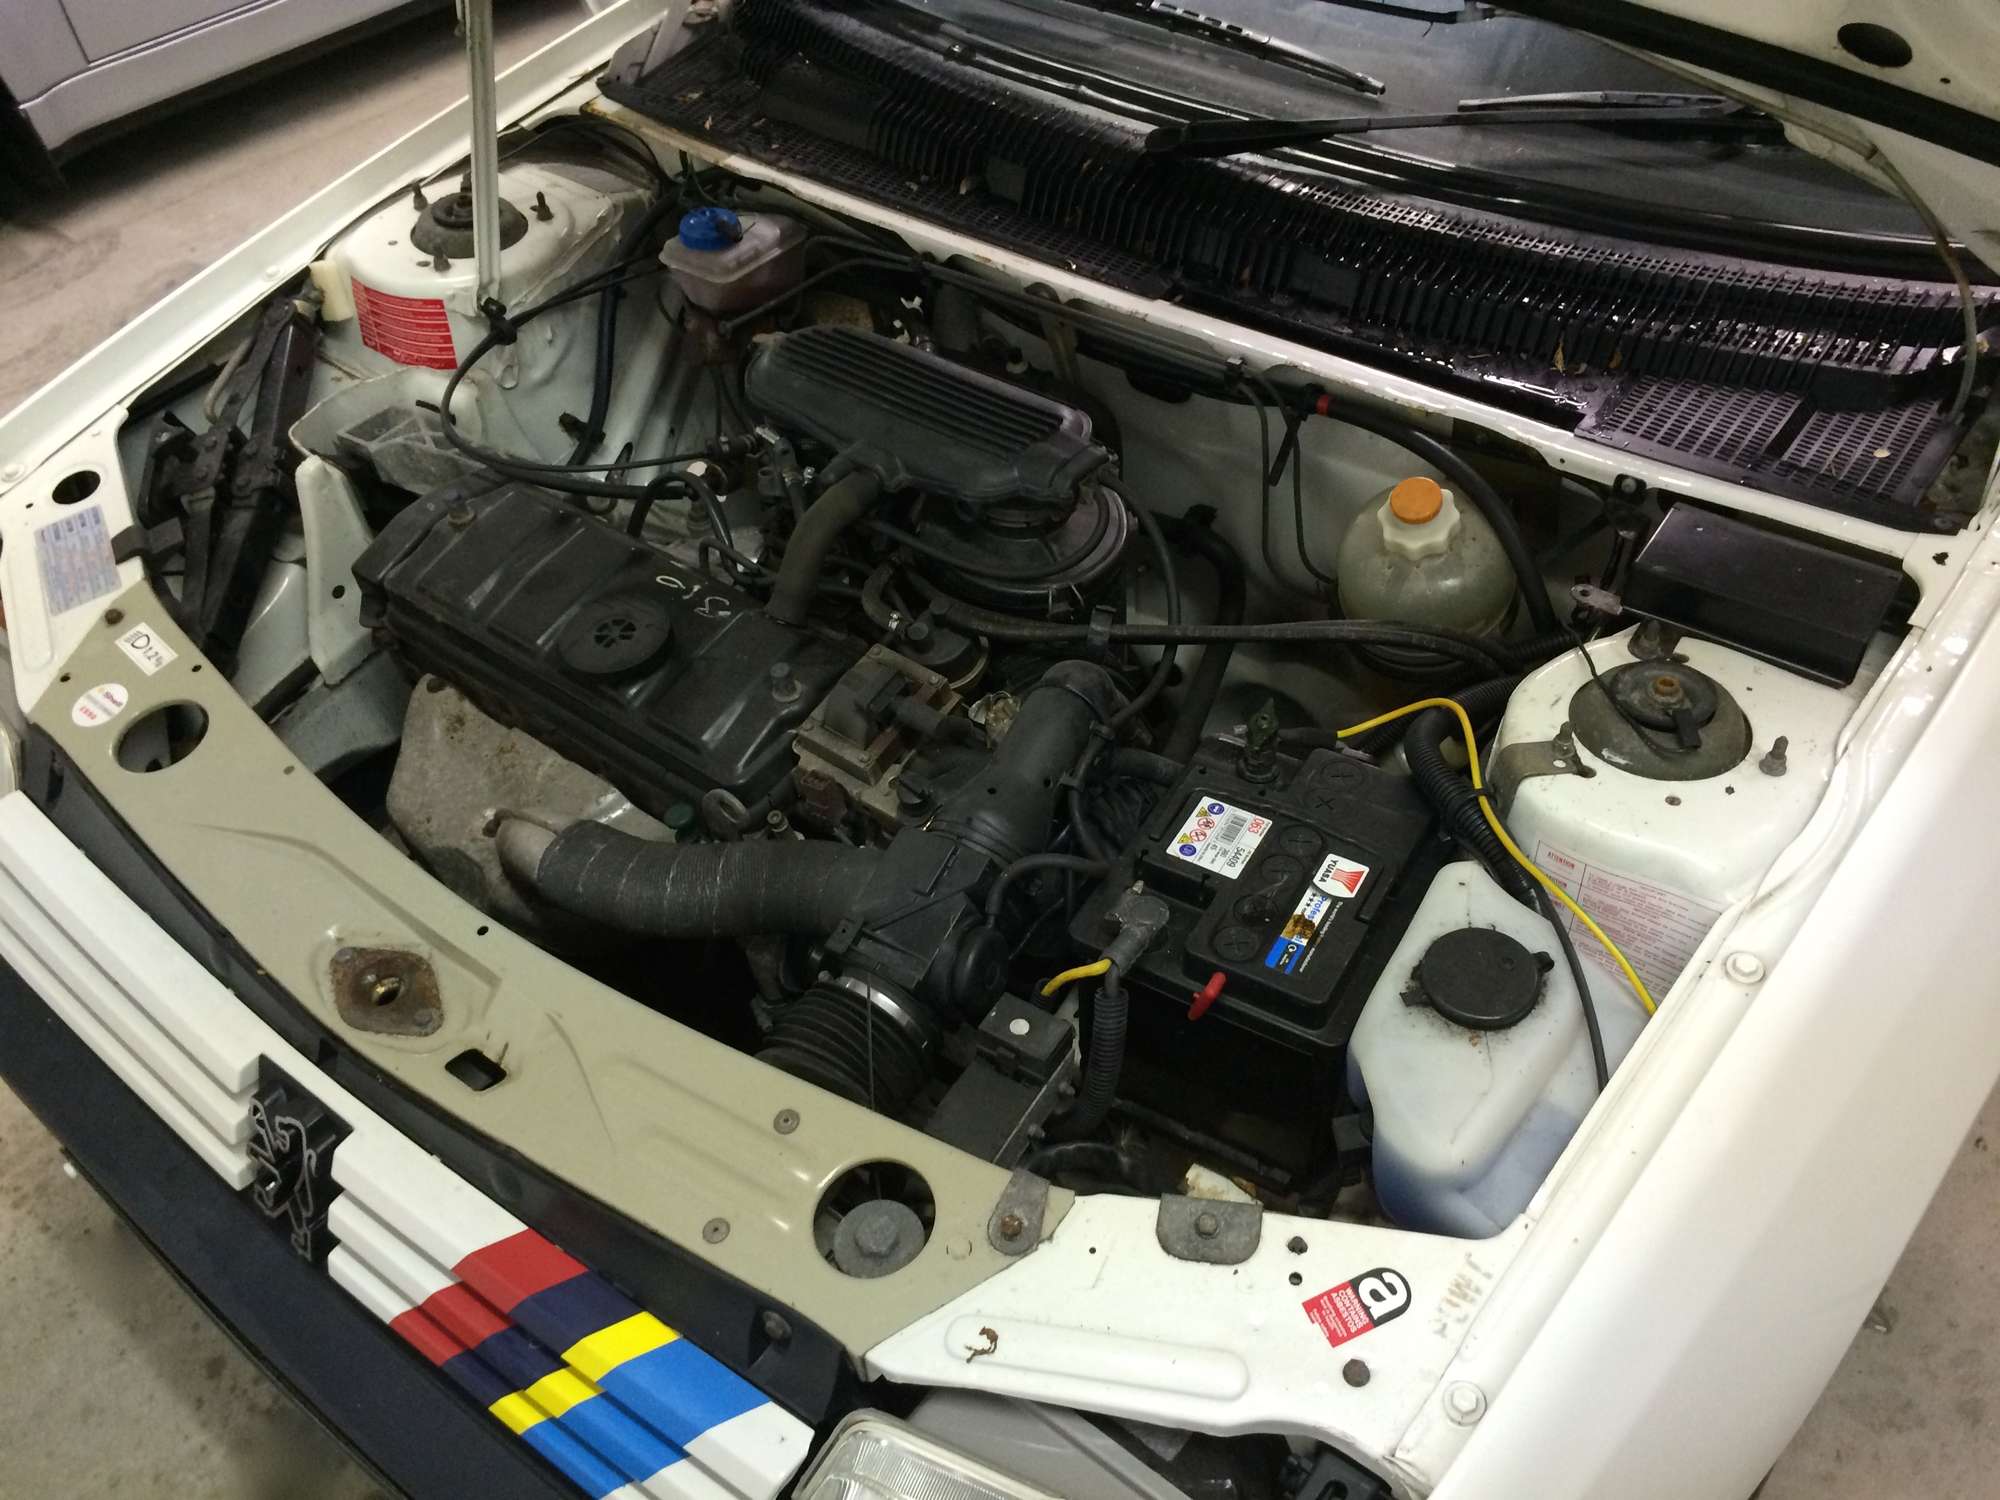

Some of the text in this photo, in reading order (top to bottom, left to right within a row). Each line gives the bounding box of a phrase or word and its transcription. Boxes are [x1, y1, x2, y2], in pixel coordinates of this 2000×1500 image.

[1248, 817, 1265, 834] 063
[1226, 846, 1246, 868] 54409
[1319, 859, 1339, 883] YUASA
[1330, 1292, 1357, 1333] ASBESTOS
[1338, 1289, 1364, 1329] CONTAINS
[1345, 1287, 1370, 1325] WARNING
[1359, 1271, 1408, 1320] a
